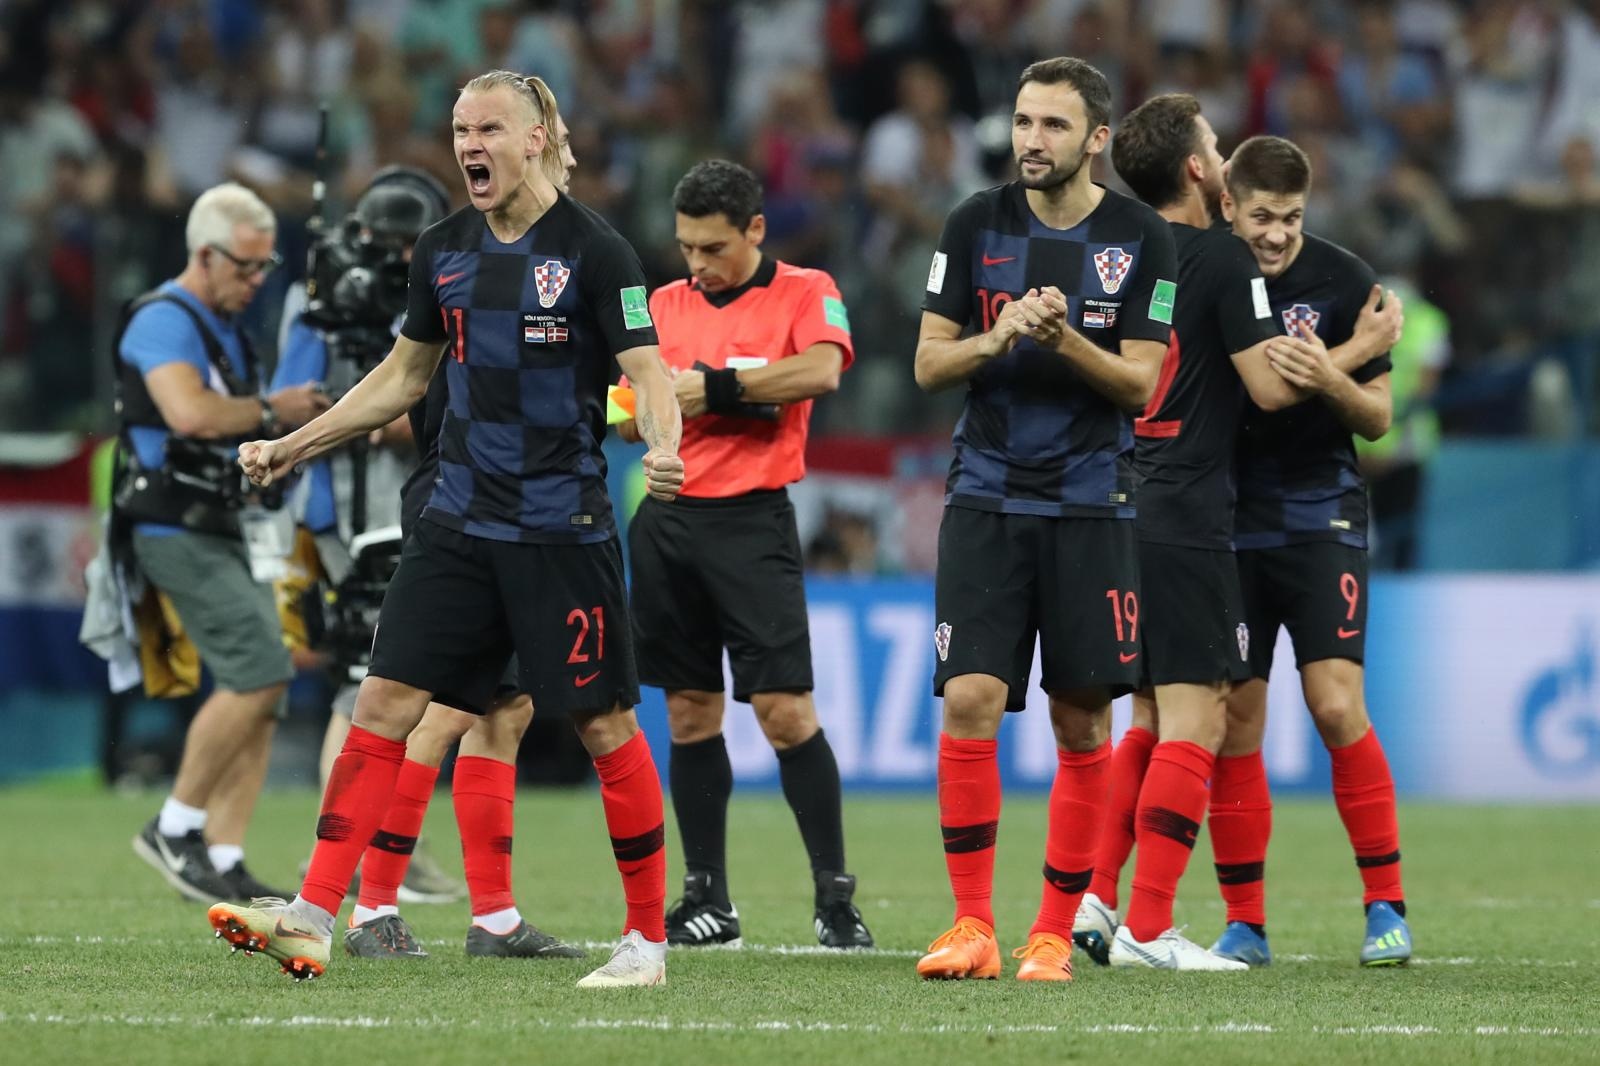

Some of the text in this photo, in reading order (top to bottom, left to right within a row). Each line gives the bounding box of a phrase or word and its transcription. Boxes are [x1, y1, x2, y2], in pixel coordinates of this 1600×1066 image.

[1106, 589, 1138, 641] 19
[1340, 573, 1359, 620] 9
[566, 606, 604, 664] 21
